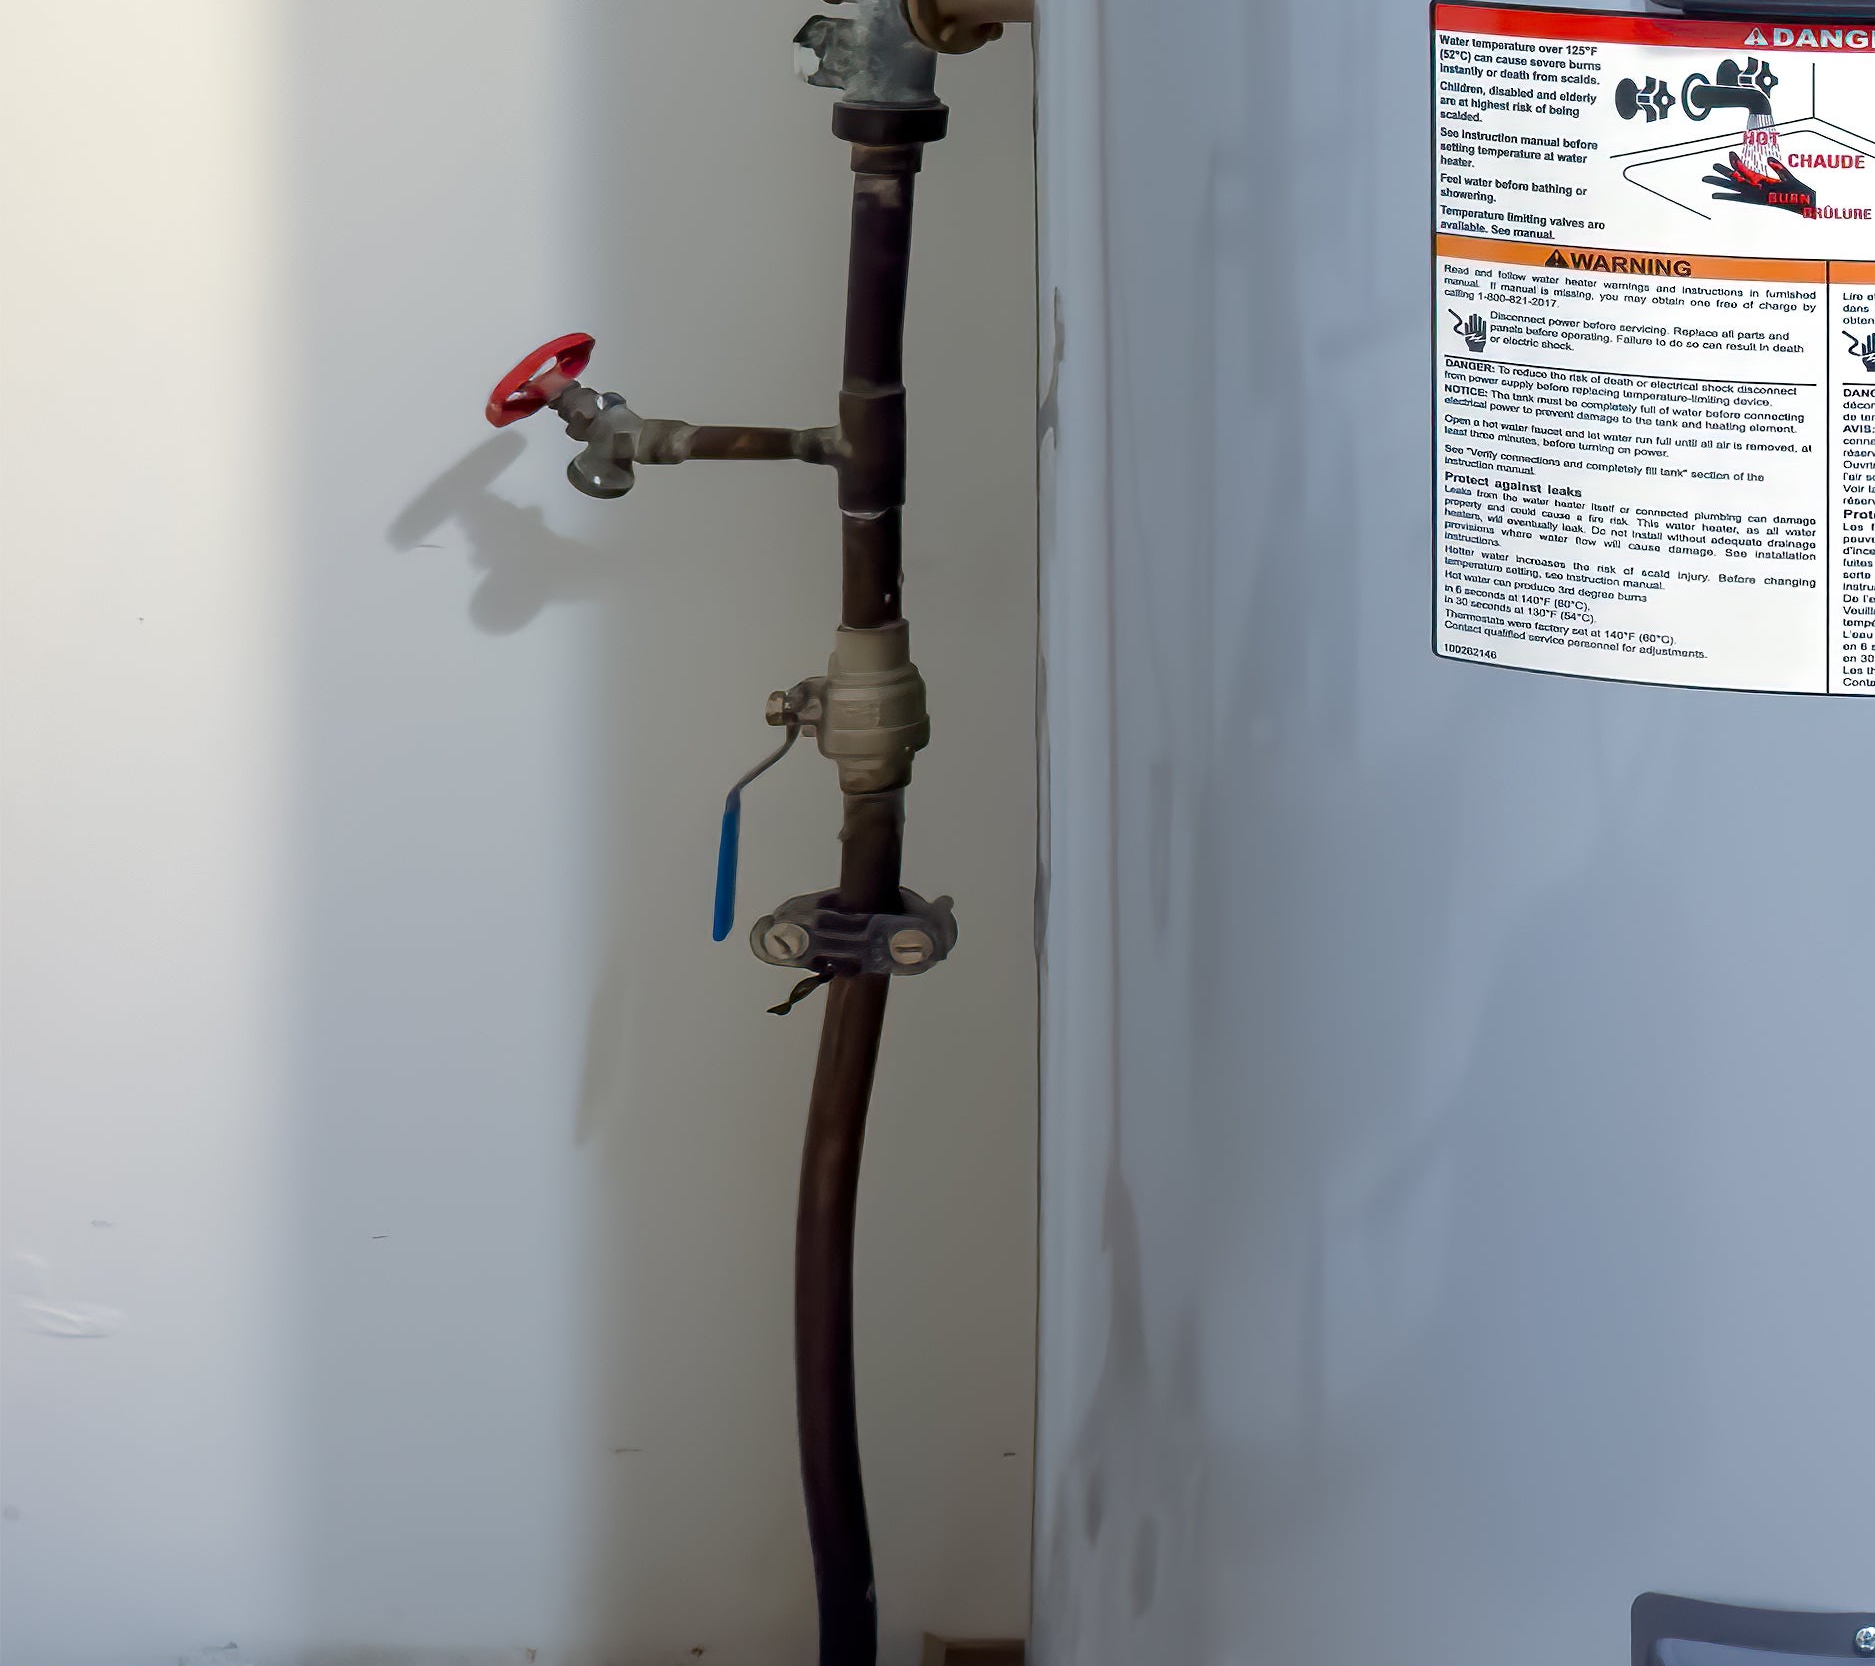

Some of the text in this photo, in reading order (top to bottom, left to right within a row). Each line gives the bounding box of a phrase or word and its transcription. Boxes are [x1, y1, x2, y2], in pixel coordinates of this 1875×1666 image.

[1439, 34, 1597, 56] Water temperature over 125°F
[1439, 49, 1601, 71] (52°C) can cause severe burns
[1486, 69, 1497, 78] or
[1499, 68, 1529, 80] death
[1532, 70, 1557, 82] from
[1560, 72, 1599, 85] scalds.
[1439, 80, 1596, 105] Children, disabled and elderly
[1440, 96, 1579, 118] are at highest risk of being
[1440, 109, 1482, 122] scalded.
[1440, 127, 1459, 139] See
[1520, 133, 1559, 147] manual
[1562, 136, 1598, 150] before
[1742, 131, 1780, 146] HOT
[1440, 141, 1587, 163] setting temperature at water
[1788, 153, 1866, 169] CHAUDE
[1440, 155, 1474, 169] heater.
[1440, 172, 1587, 197] Feel water before bathing or
[1440, 187, 1496, 205] showering.
[1768, 192, 1810, 205] BURN
[1440, 206, 1605, 230] Temperature limiting valves are
[1802, 204, 1872, 220] BRÛLURE
[1440, 219, 1555, 239] available. See manual.
[1569, 252, 1693, 277] WARNING
[1445, 359, 1495, 374] DANGER:
[1444, 384, 1488, 398] NOTICE:
[1842, 424, 1875, 435] AVIS:
[1444, 471, 1581, 498] Protect against leaks
